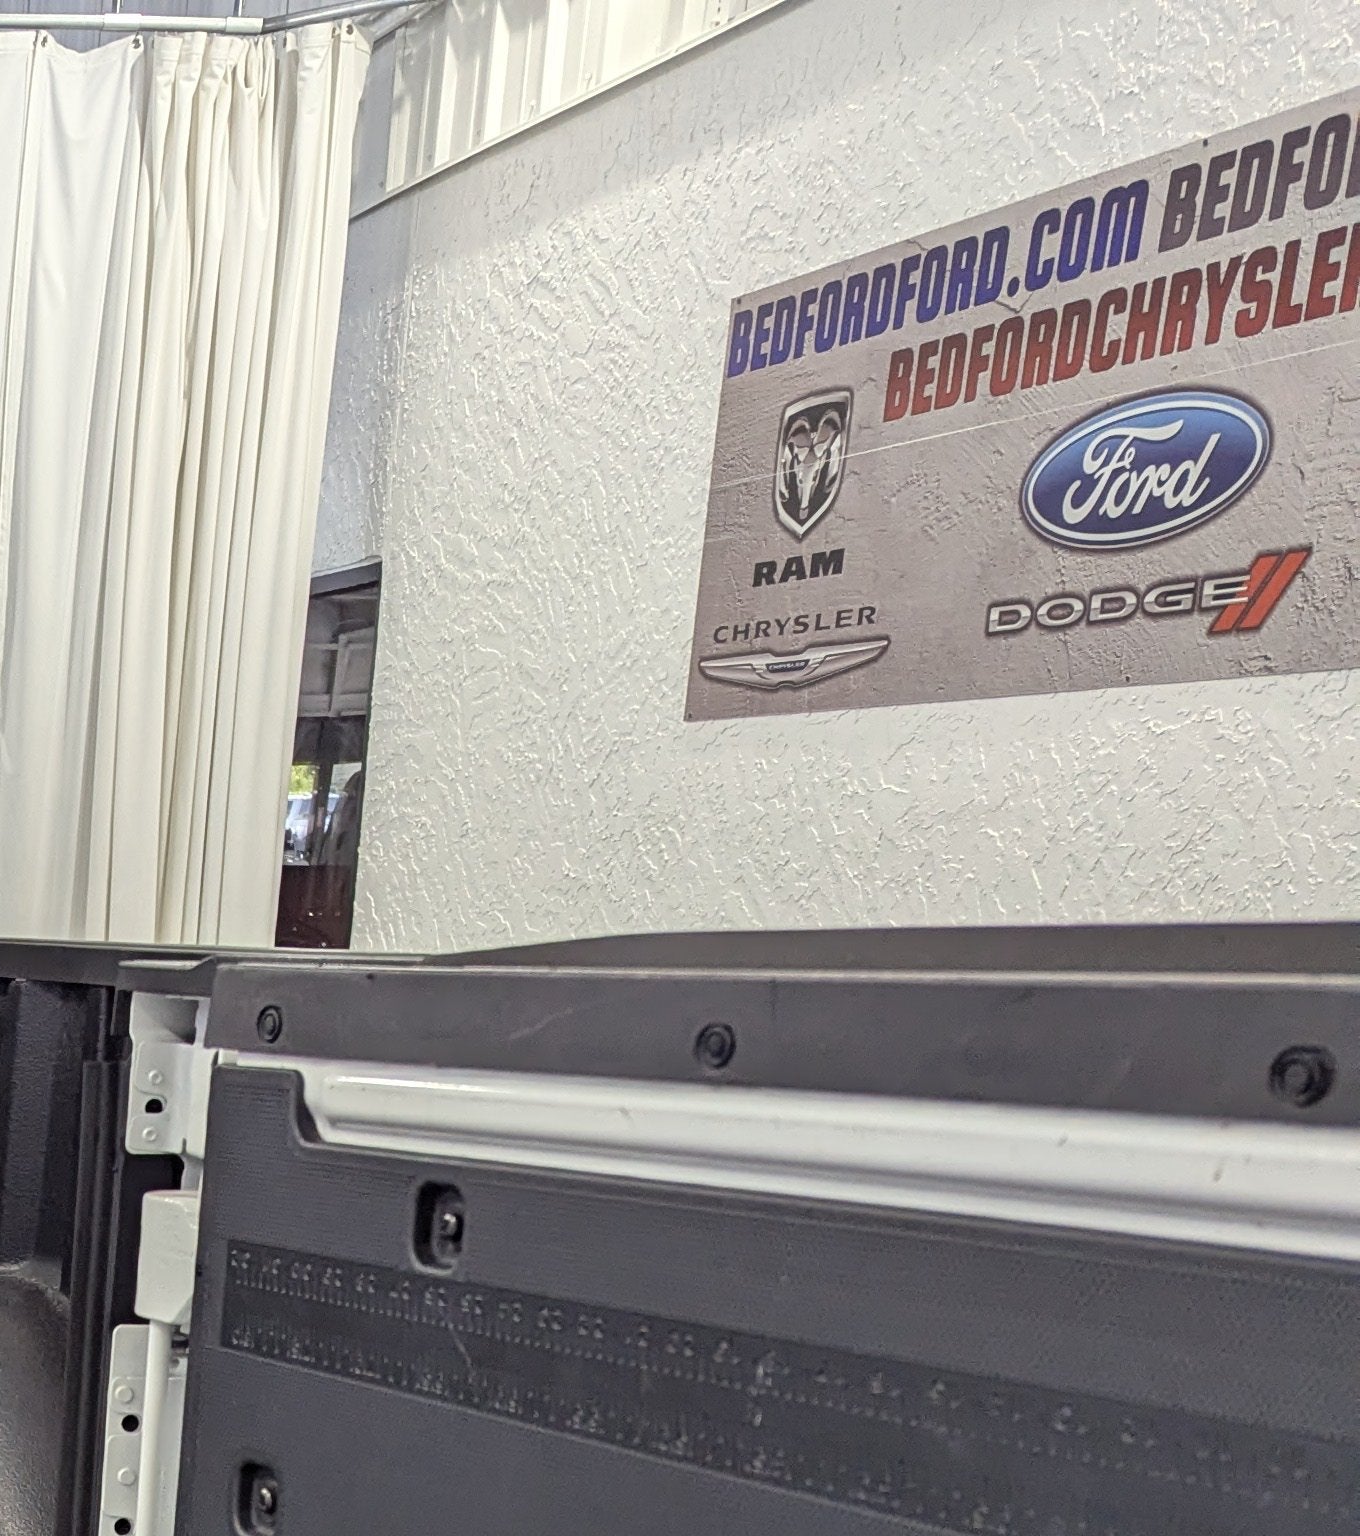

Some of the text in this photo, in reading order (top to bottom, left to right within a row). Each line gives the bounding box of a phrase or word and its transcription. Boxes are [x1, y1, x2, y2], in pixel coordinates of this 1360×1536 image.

[727, 180, 1150, 378] BEDFORDFORD.COM
[1062, 419, 1222, 526] Ford
[752, 549, 845, 588] RAM
[713, 606, 876, 643] CHRYSLER
[986, 576, 1249, 636] DODGE
